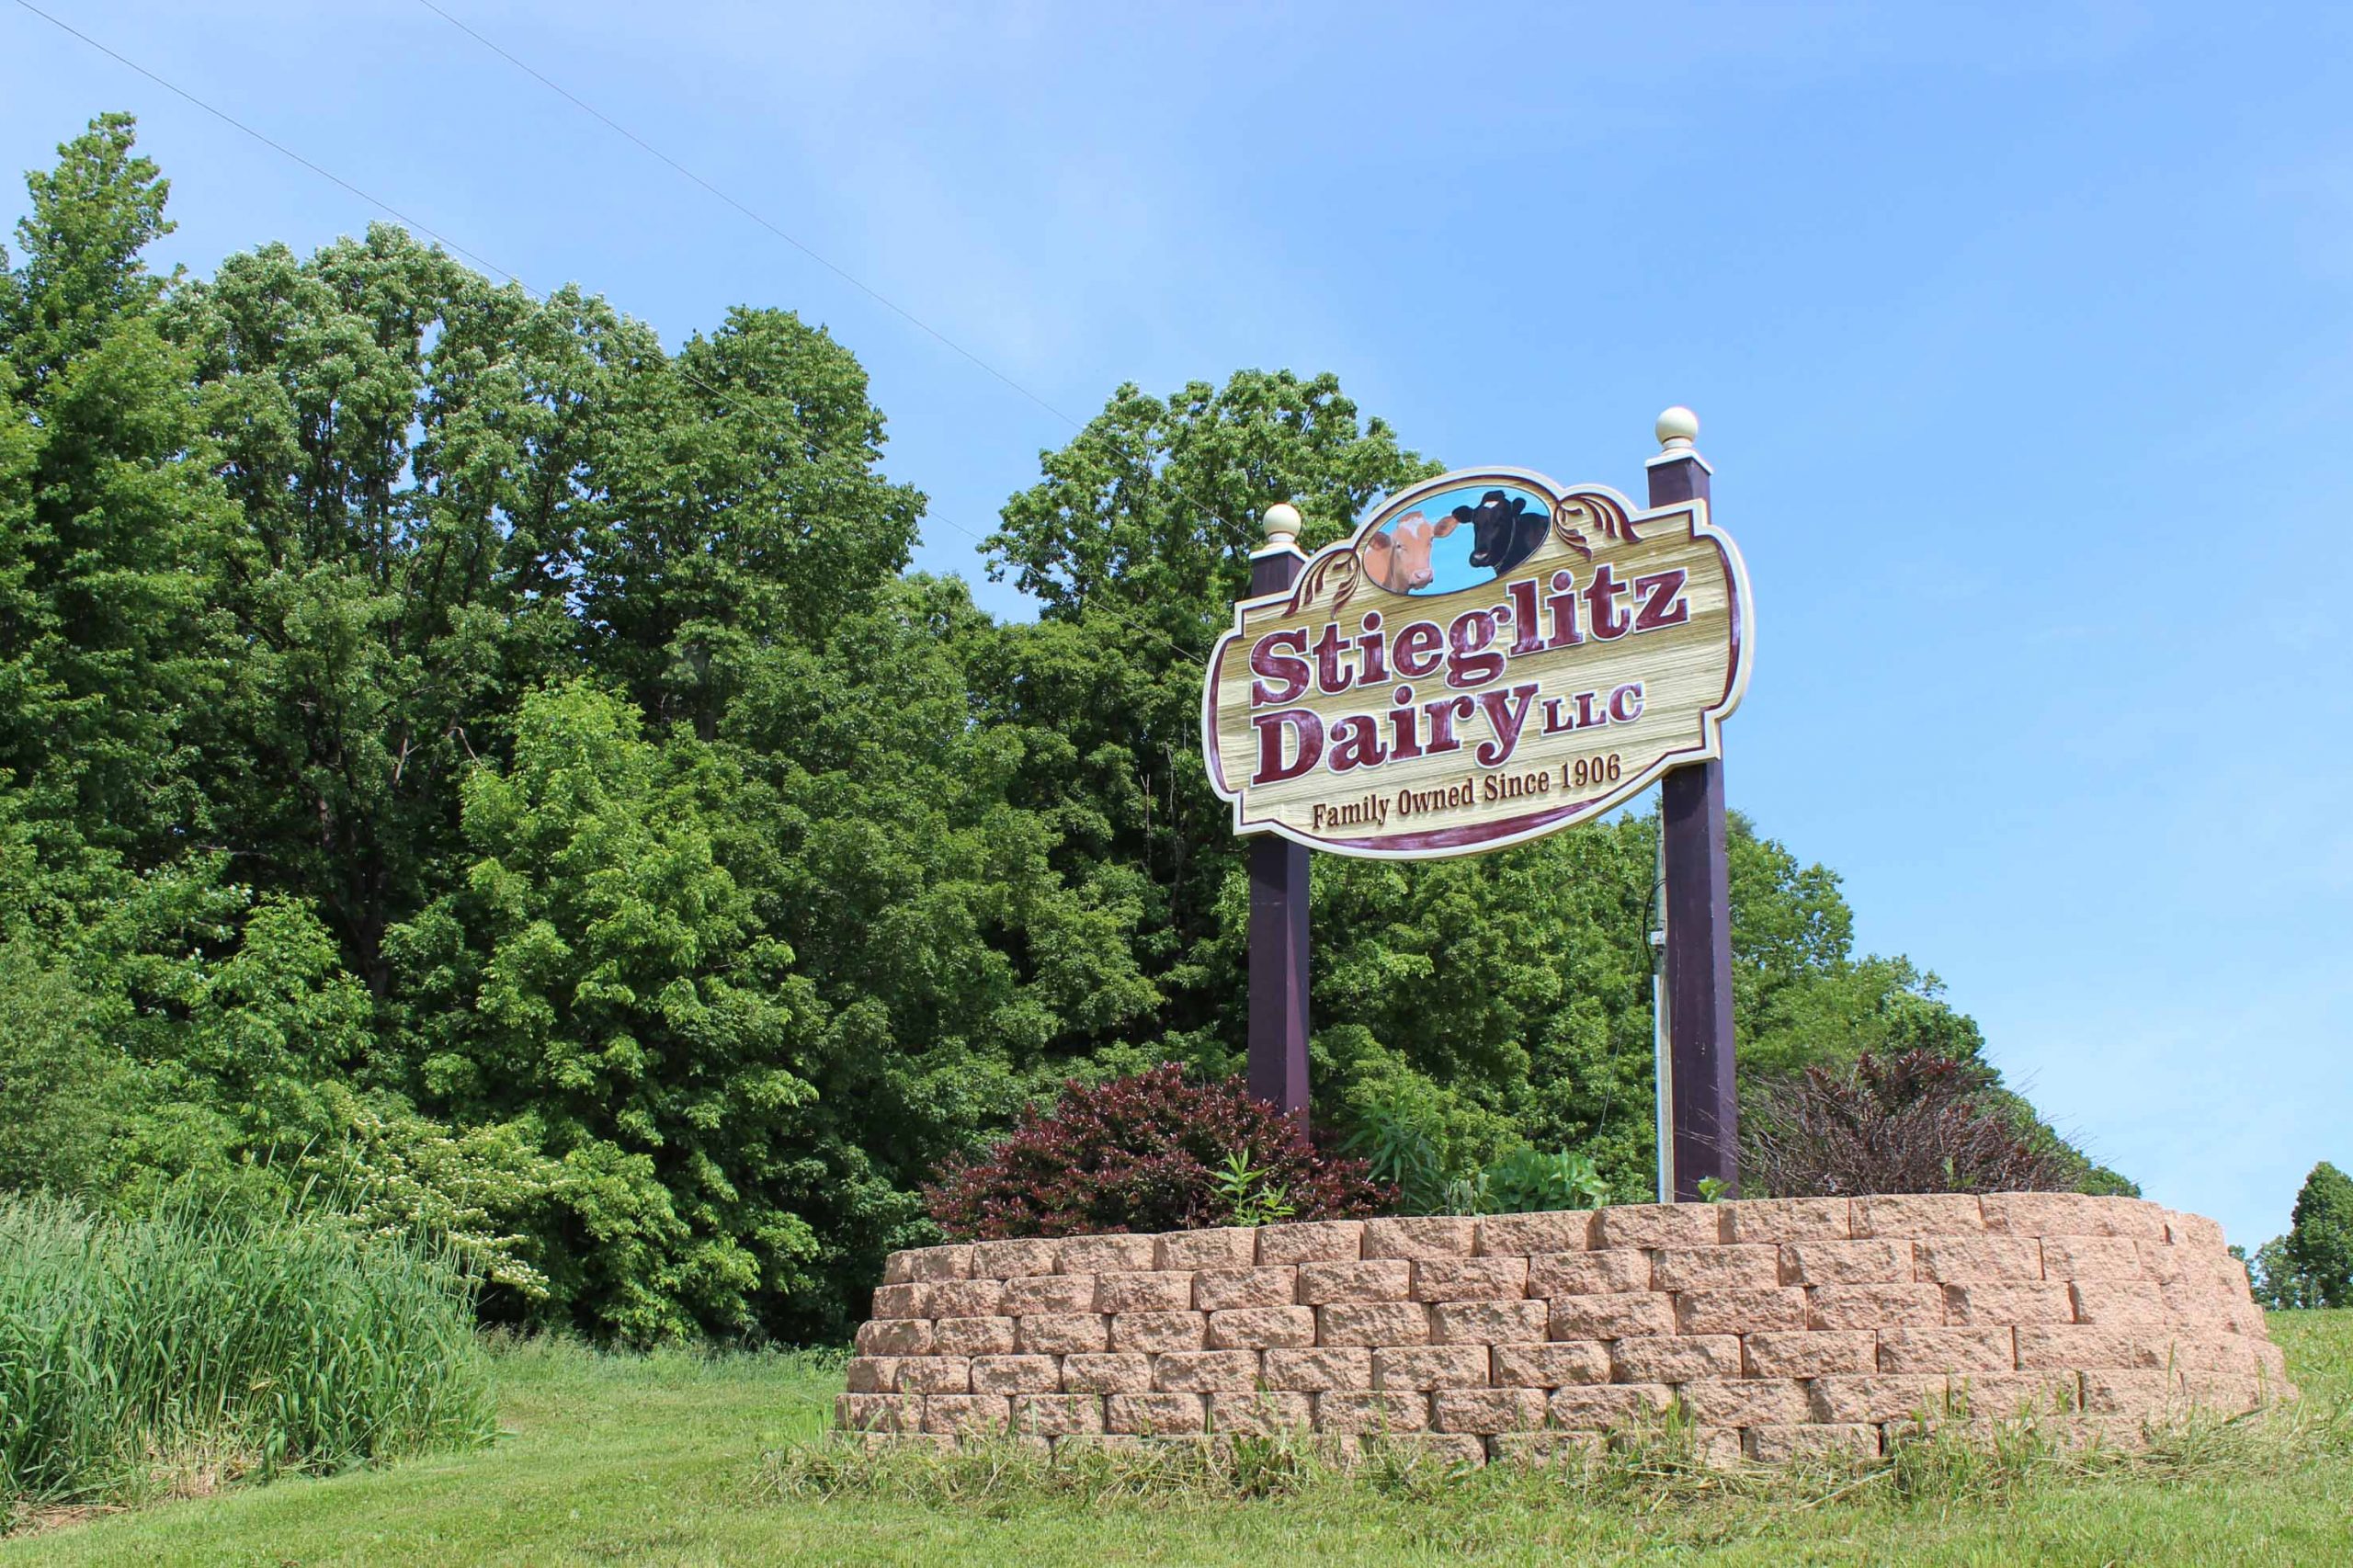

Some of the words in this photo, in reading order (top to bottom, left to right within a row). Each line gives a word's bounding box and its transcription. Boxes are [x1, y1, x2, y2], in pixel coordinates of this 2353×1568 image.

[1251, 564, 1689, 708] Stieglitz
[1251, 684, 1539, 786] Dairy
[1542, 683, 1644, 735] LLC
[1313, 793, 1389, 829] Family
[1398, 778, 1474, 815] Owned
[1483, 767, 1550, 801] Since
[1562, 755, 1621, 788] 1906
